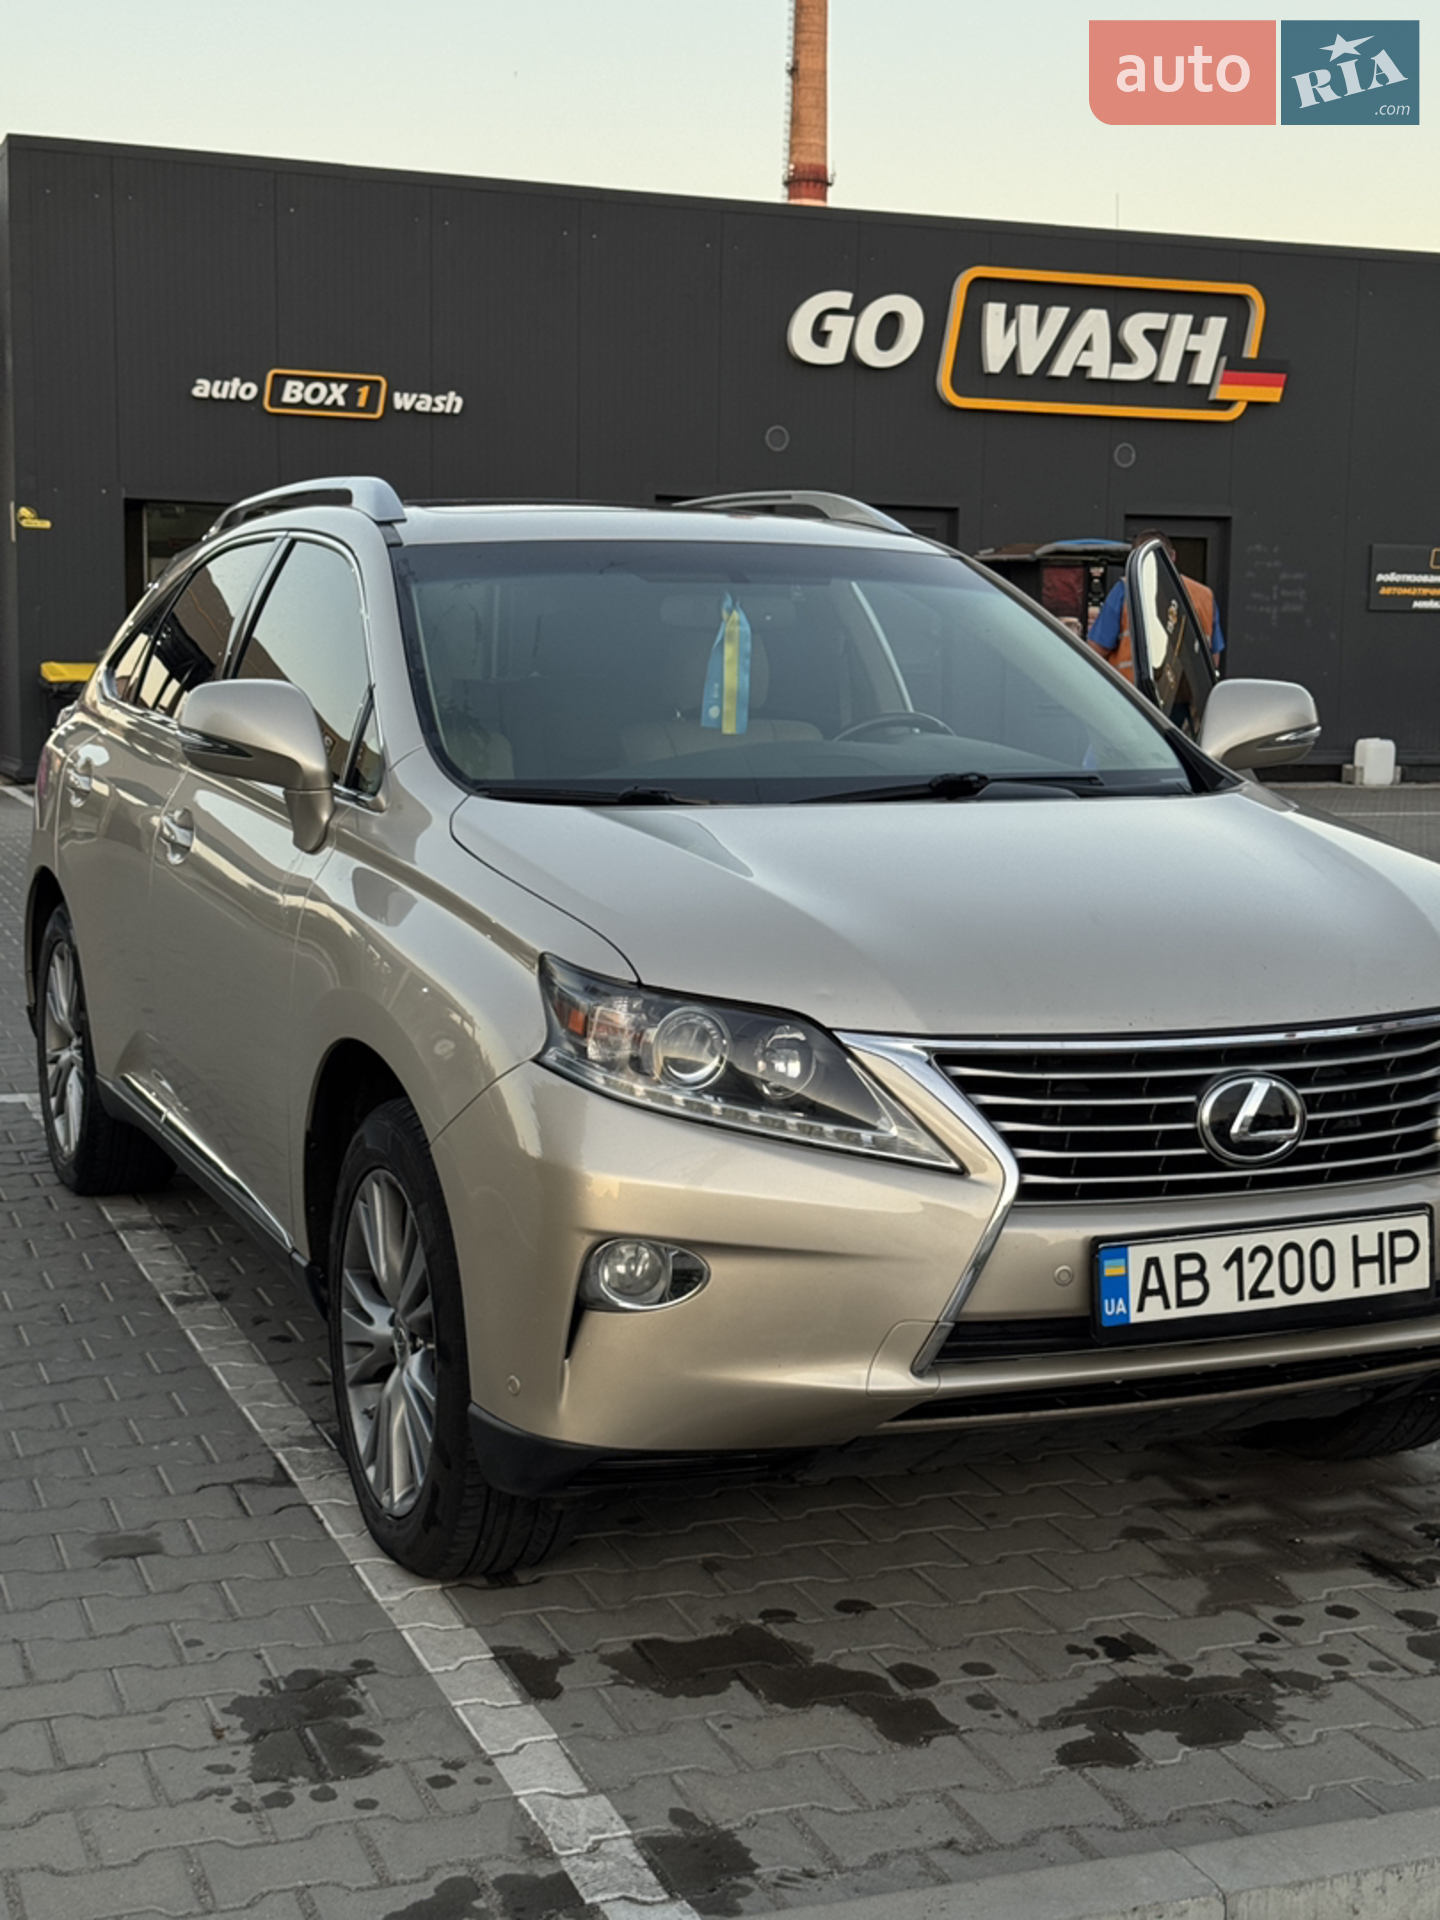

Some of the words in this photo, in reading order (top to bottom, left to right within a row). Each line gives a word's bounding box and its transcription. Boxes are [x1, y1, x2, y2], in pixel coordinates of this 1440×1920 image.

[786, 290, 925, 369] GO
[981, 301, 1228, 385] WASH
[191, 377, 258, 401] auto
[281, 379, 349, 406] BOX
[356, 385, 370, 408] 1
[393, 391, 464, 414] wash
[1136, 1252, 1210, 1313] AB
[1222, 1238, 1336, 1302] 1200
[1351, 1229, 1420, 1288] HP
[1104, 1298, 1127, 1316] UA
